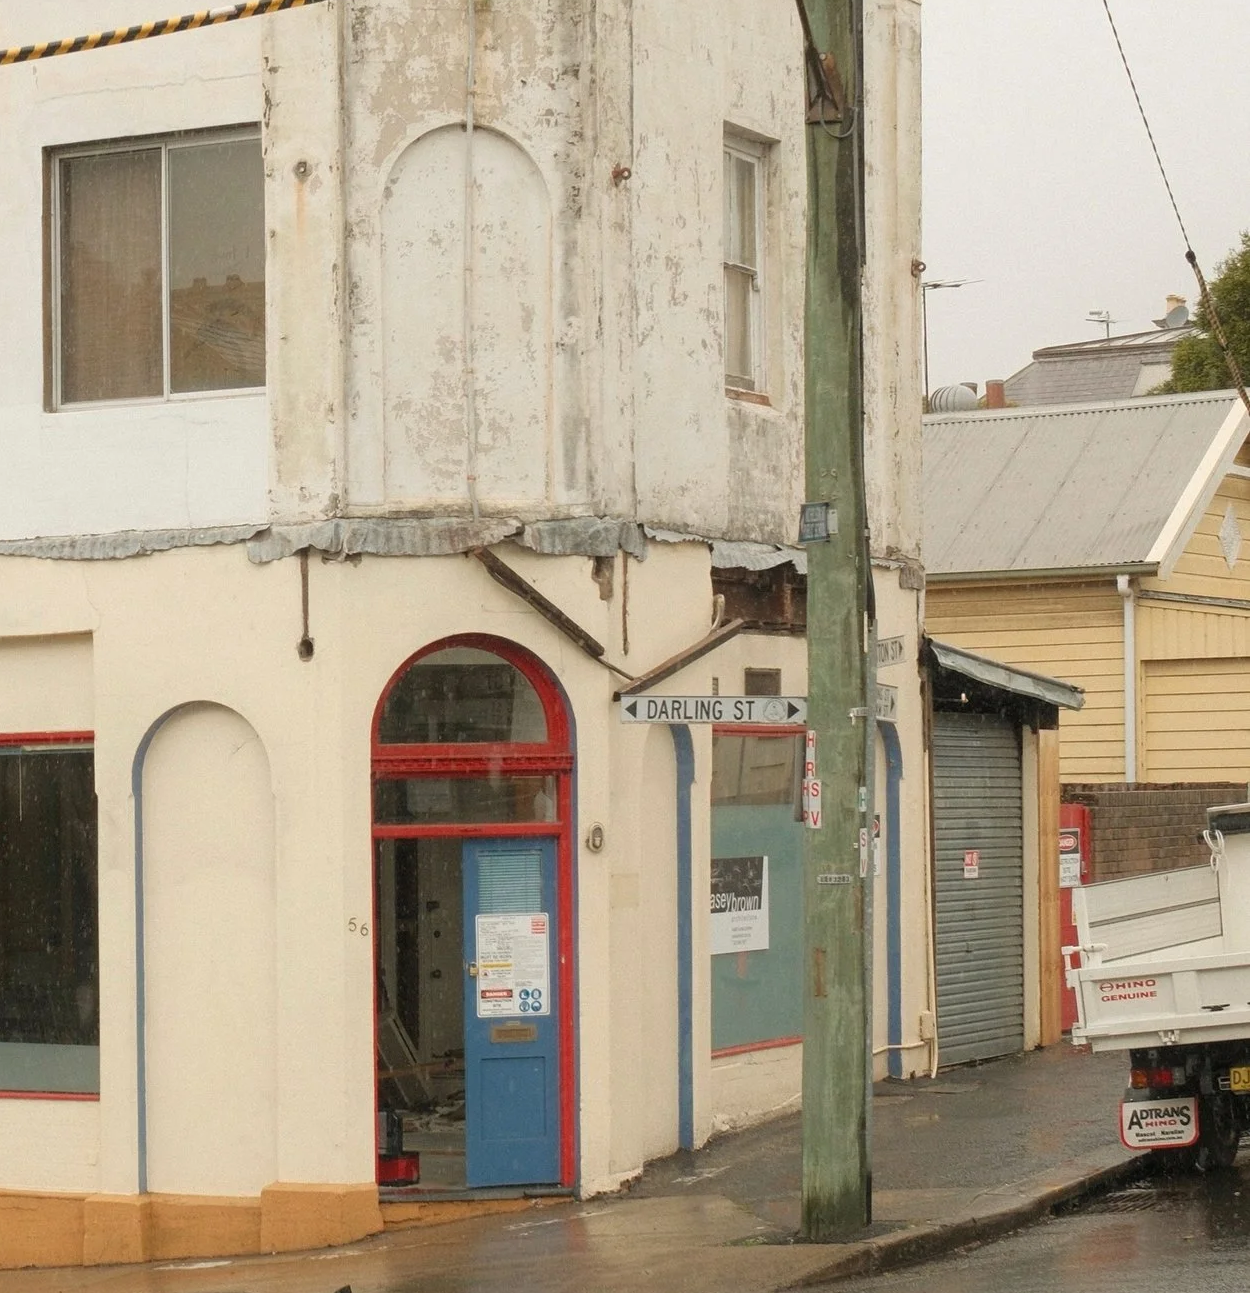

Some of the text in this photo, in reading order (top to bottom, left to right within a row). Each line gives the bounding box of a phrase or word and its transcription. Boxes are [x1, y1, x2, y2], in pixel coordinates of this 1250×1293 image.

[877, 641, 889, 663] TON
[647, 700, 755, 721] DARLING ST
[710, 891, 759, 914] aseybrown
[348, 917, 369, 937] 56
[1115, 979, 1156, 990] HINO
[1101, 991, 1158, 1002] GENUINE
[1127, 1105, 1191, 1131] ADTRANS
[1145, 1119, 1177, 1128] HINO
